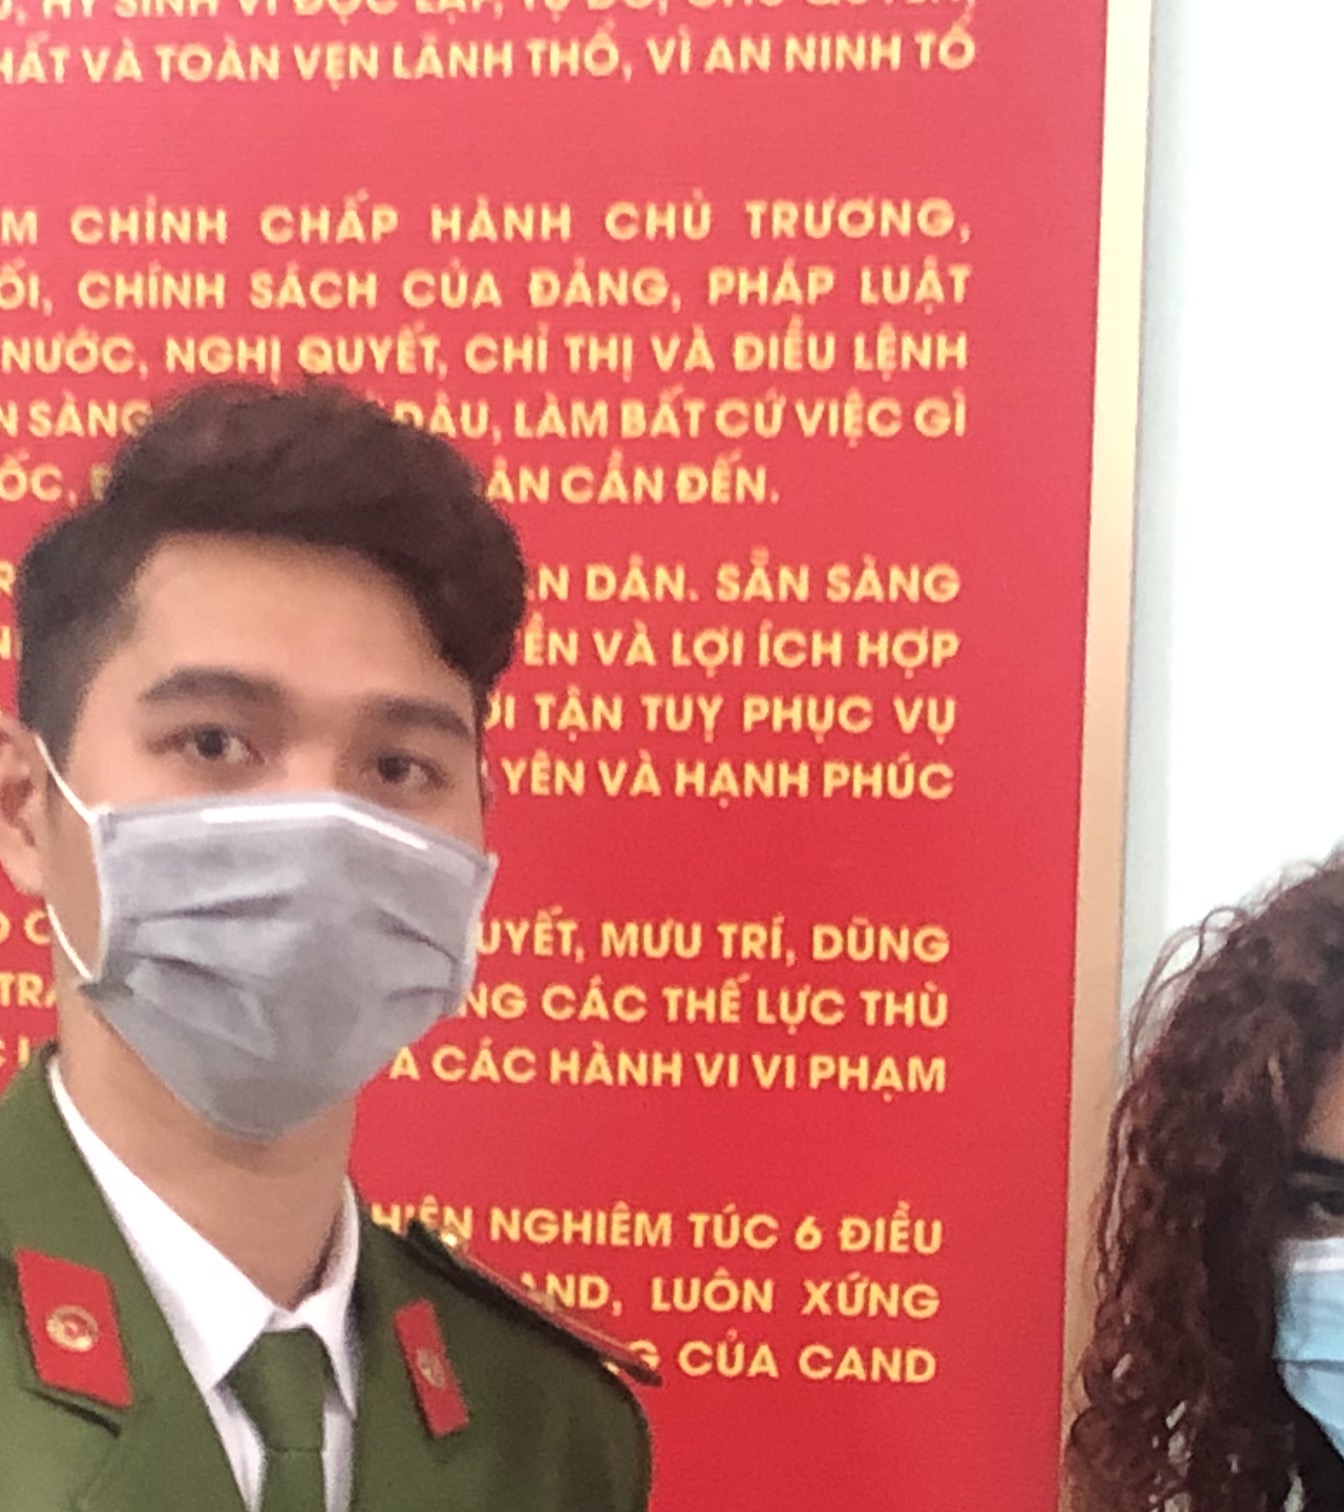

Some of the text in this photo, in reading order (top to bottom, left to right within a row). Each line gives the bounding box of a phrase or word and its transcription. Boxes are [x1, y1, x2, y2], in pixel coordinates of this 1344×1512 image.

[81, 37, 143, 83] VÀ
[155, 36, 280, 82] TOÀN
[294, 42, 379, 90] VẸN
[393, 31, 513, 79] LÃNH
[526, 19, 632, 82] THỔ,
[646, 26, 691, 75] VÌ
[705, 35, 771, 73] AN
[785, 33, 902, 72] NINH
[915, 14, 976, 70] TỔ
[70, 195, 227, 244] CHỈNH
[260, 190, 398, 244] CHẤP
[431, 195, 571, 242] HÀNH
[605, 189, 712, 240] CHỦ
[745, 196, 970, 243] TRƯƠNG,
[78, 263, 225, 309] CHÍNH
[250, 262, 377, 309] SÁCH
[402, 258, 502, 308] CỦA
[528, 257, 681, 312] ĐẢNG,
[709, 257, 835, 305] PHÁP
[861, 255, 971, 314] LUẬT
[1, 327, 148, 379] NƯỚC,
[166, 335, 281, 384] NGHỊ
[298, 321, 447, 379] QUYẾT,
[465, 323, 548, 373] CHỈ
[564, 334, 633, 382] THỊ
[651, 324, 715, 372] VÀ
[733, 315, 835, 371] ĐIỀU
[854, 321, 967, 381] LỆNH
[514, 392, 608, 438] LÀM
[621, 385, 706, 438] BẤT
[715, 389, 786, 438] CỨ
[795, 388, 902, 447] VIỆC
[914, 388, 966, 437] GÌ
[485, 456, 550, 503] ÂN
[561, 448, 664, 504] CẦN
[675, 449, 779, 503] ĐẾN.
[586, 554, 698, 602] DÂN.
[716, 548, 809, 602] SẴN
[827, 555, 960, 603] SÀNG
[593, 620, 656, 666] VÀ
[672, 626, 744, 677] LỢI
[759, 620, 842, 668] ÍCH
[858, 627, 960, 678] HỢP
[534, 684, 622, 741] TẬN
[641, 694, 723, 742] TUỴ
[743, 695, 872, 743] PHỤC
[893, 696, 956, 744] VỤ
[502, 749, 585, 796] YÊN
[598, 750, 661, 796] VÀ
[675, 759, 809, 808] HẠNH
[823, 752, 953, 799] PHÚC
[476, 905, 584, 963] UYẾT,
[601, 918, 702, 959] MƯU
[717, 913, 796, 967] TRÍ,
[812, 916, 949, 963] DŨNG
[542, 975, 647, 1022] CÁC
[662, 972, 750, 1023] THẾ
[757, 984, 845, 1035] LỰC
[860, 981, 948, 1028] THÙ
[432, 1036, 536, 1083] CÁC
[550, 1041, 682, 1087] HÀNH
[695, 1052, 739, 1088] VI
[752, 1052, 796, 1089] VI
[809, 1054, 946, 1102] PHẠM
[490, 1201, 672, 1247] NGHIÊM
[688, 1203, 779, 1249] TÚC
[795, 1215, 822, 1251] 6
[838, 1200, 942, 1255] ĐIỀU
[521, 1267, 940, 1319] ND, LUÔN XỨNG
[678, 1329, 779, 1378] CỦA
[798, 1343, 936, 1383] CAND
